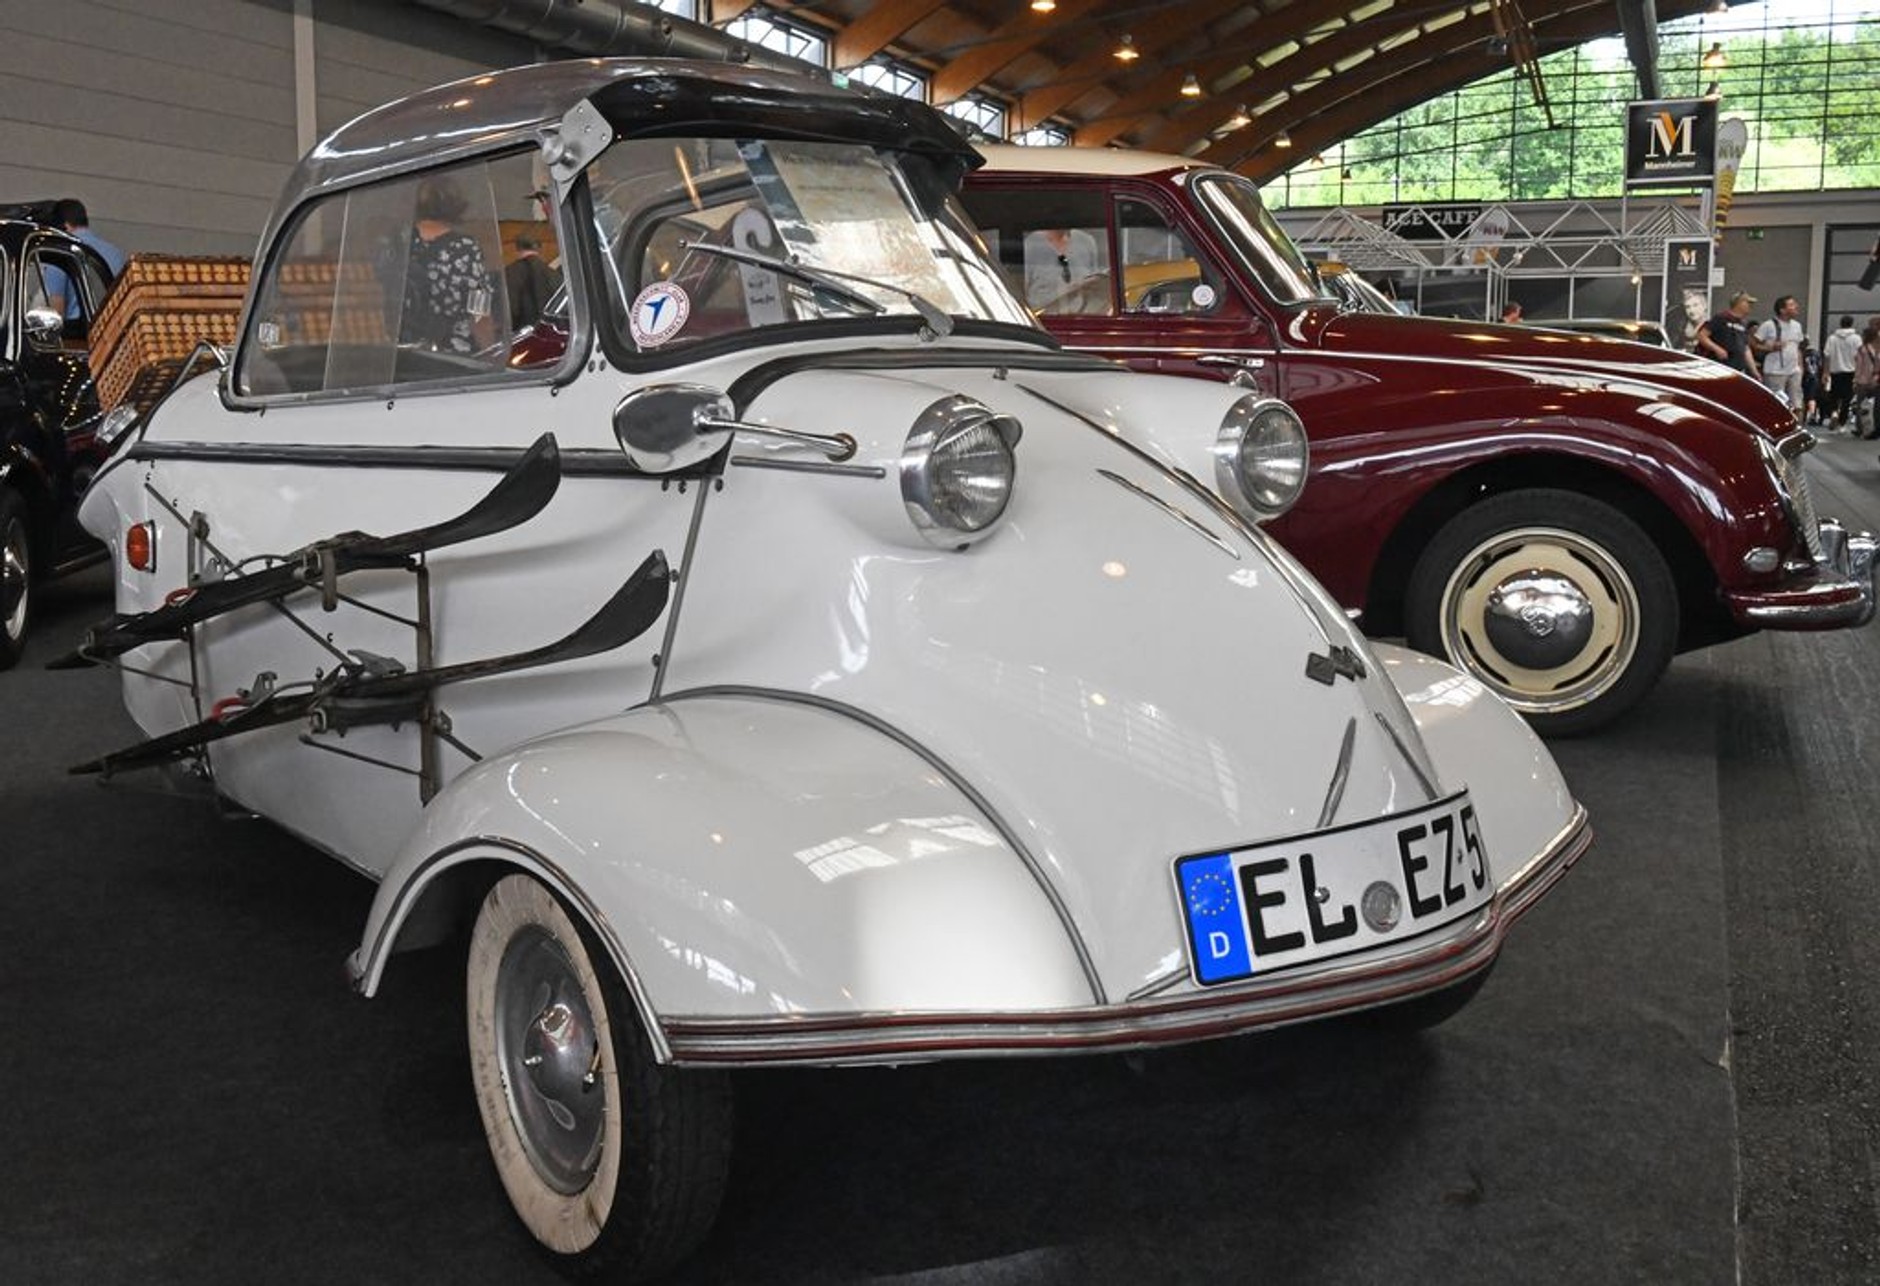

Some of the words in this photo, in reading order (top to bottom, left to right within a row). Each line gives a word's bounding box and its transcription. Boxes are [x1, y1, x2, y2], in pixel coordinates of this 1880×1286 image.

[1645, 111, 1698, 157] M
[1385, 213, 1424, 226] ACE
[1430, 211, 1479, 225] CAFE
[1239, 853, 1358, 957] EL
[1209, 932, 1231, 959] D
